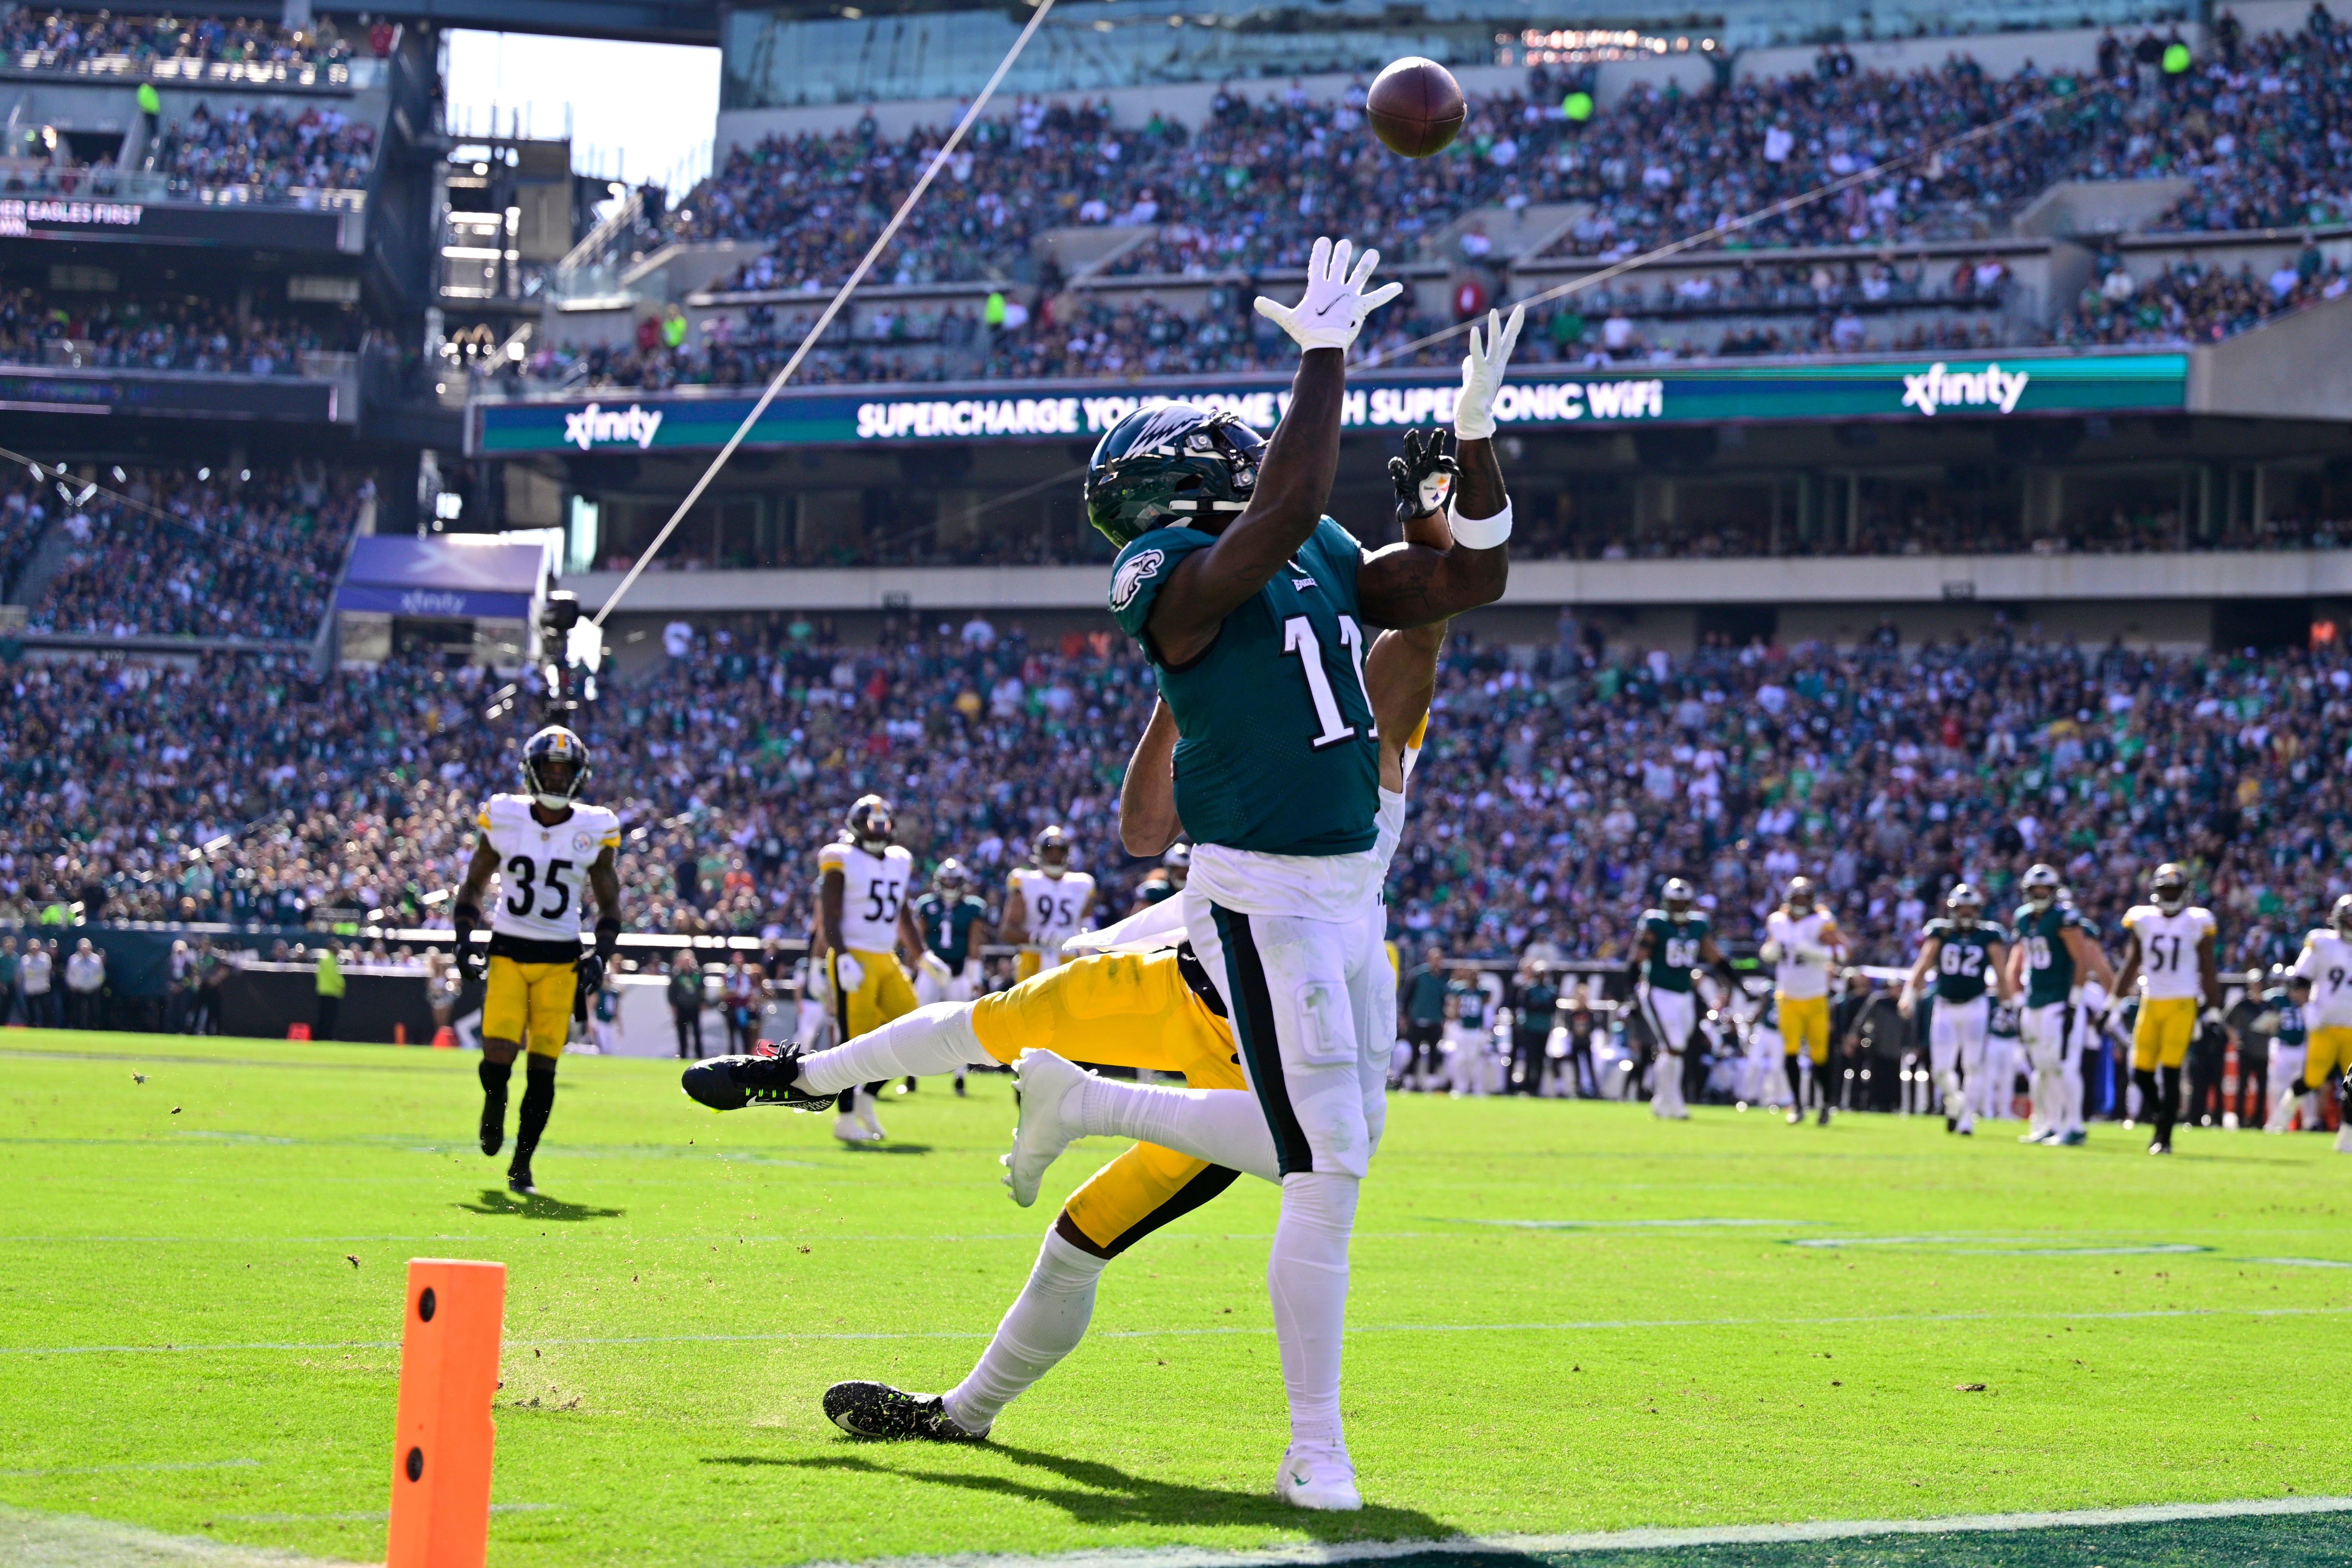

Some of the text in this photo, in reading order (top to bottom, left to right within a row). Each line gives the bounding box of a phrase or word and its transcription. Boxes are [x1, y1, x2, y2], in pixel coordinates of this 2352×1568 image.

[26, 201, 93, 223] EAGLES
[93, 204, 143, 225] FIRST
[1902, 362, 2028, 416] xfinity
[564, 402, 663, 451] xfinity
[856, 397, 1079, 438] SUPERCHARGE
[1369, 382, 1584, 425] SUPEONIC
[1282, 613, 1379, 749] 11
[507, 856, 573, 919] 35
[864, 879, 899, 923] 55
[1038, 894, 1073, 928] 95
[939, 919, 954, 949] 1
[2150, 934, 2181, 973] 51
[1940, 942, 1985, 977] 62
[2328, 966, 2352, 995] 9
